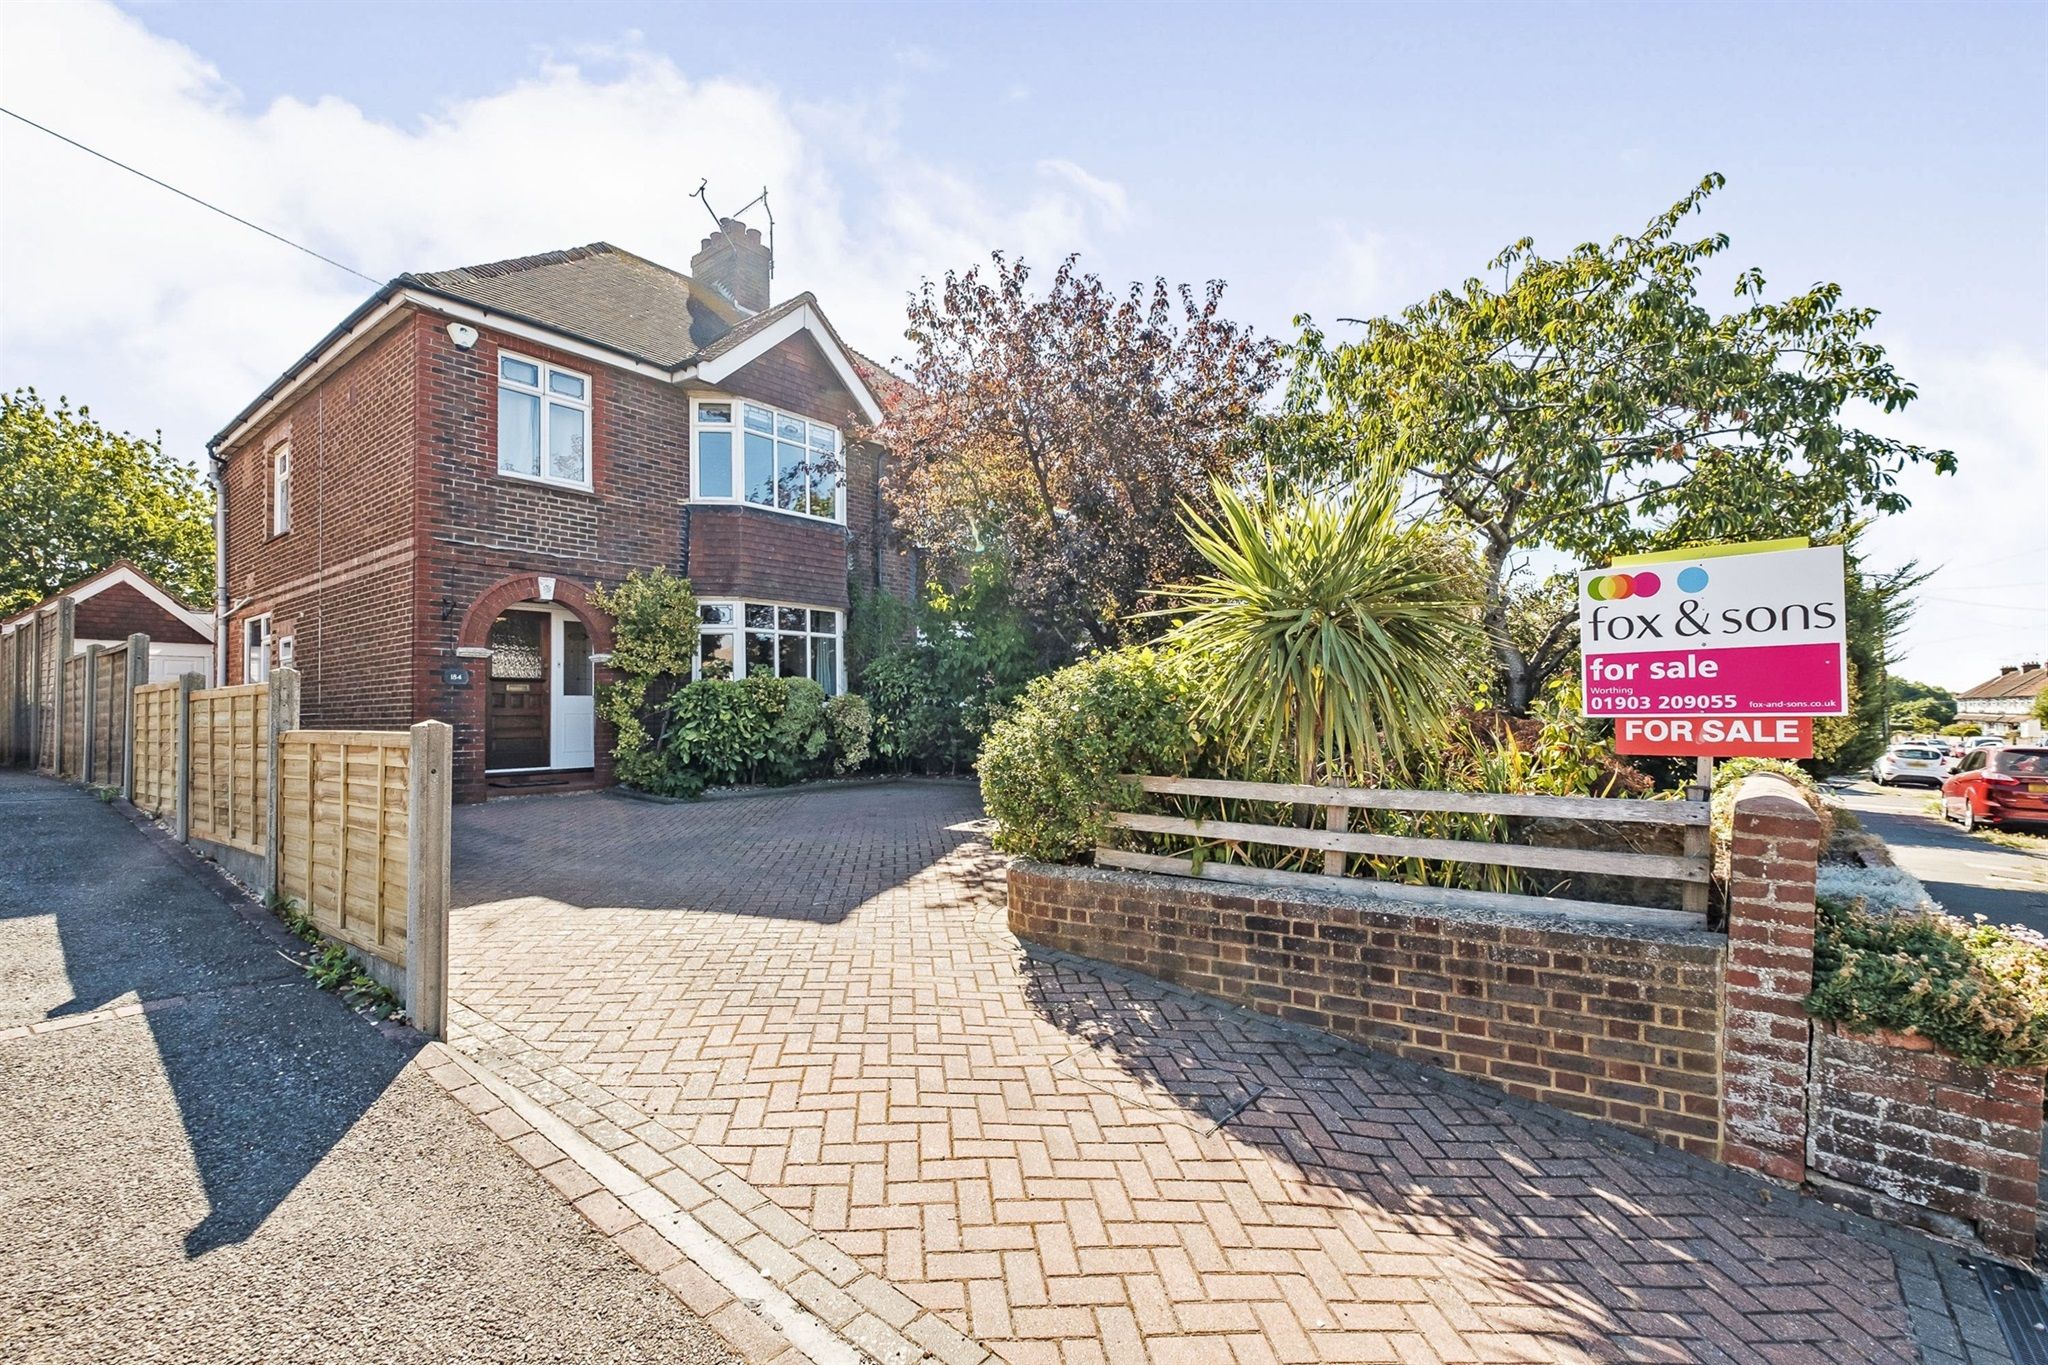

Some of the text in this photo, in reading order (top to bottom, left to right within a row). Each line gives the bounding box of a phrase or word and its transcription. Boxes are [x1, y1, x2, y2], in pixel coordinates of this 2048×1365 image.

[1588, 600, 1836, 641] fox & sons
[1590, 654, 1719, 681] for sale
[1590, 687, 1633, 695] Worthing
[1591, 695, 1737, 710] 01903 209055
[1749, 700, 1837, 708] fox-and-sons.co.uk
[1625, 720, 1800, 743] FOR SALE
